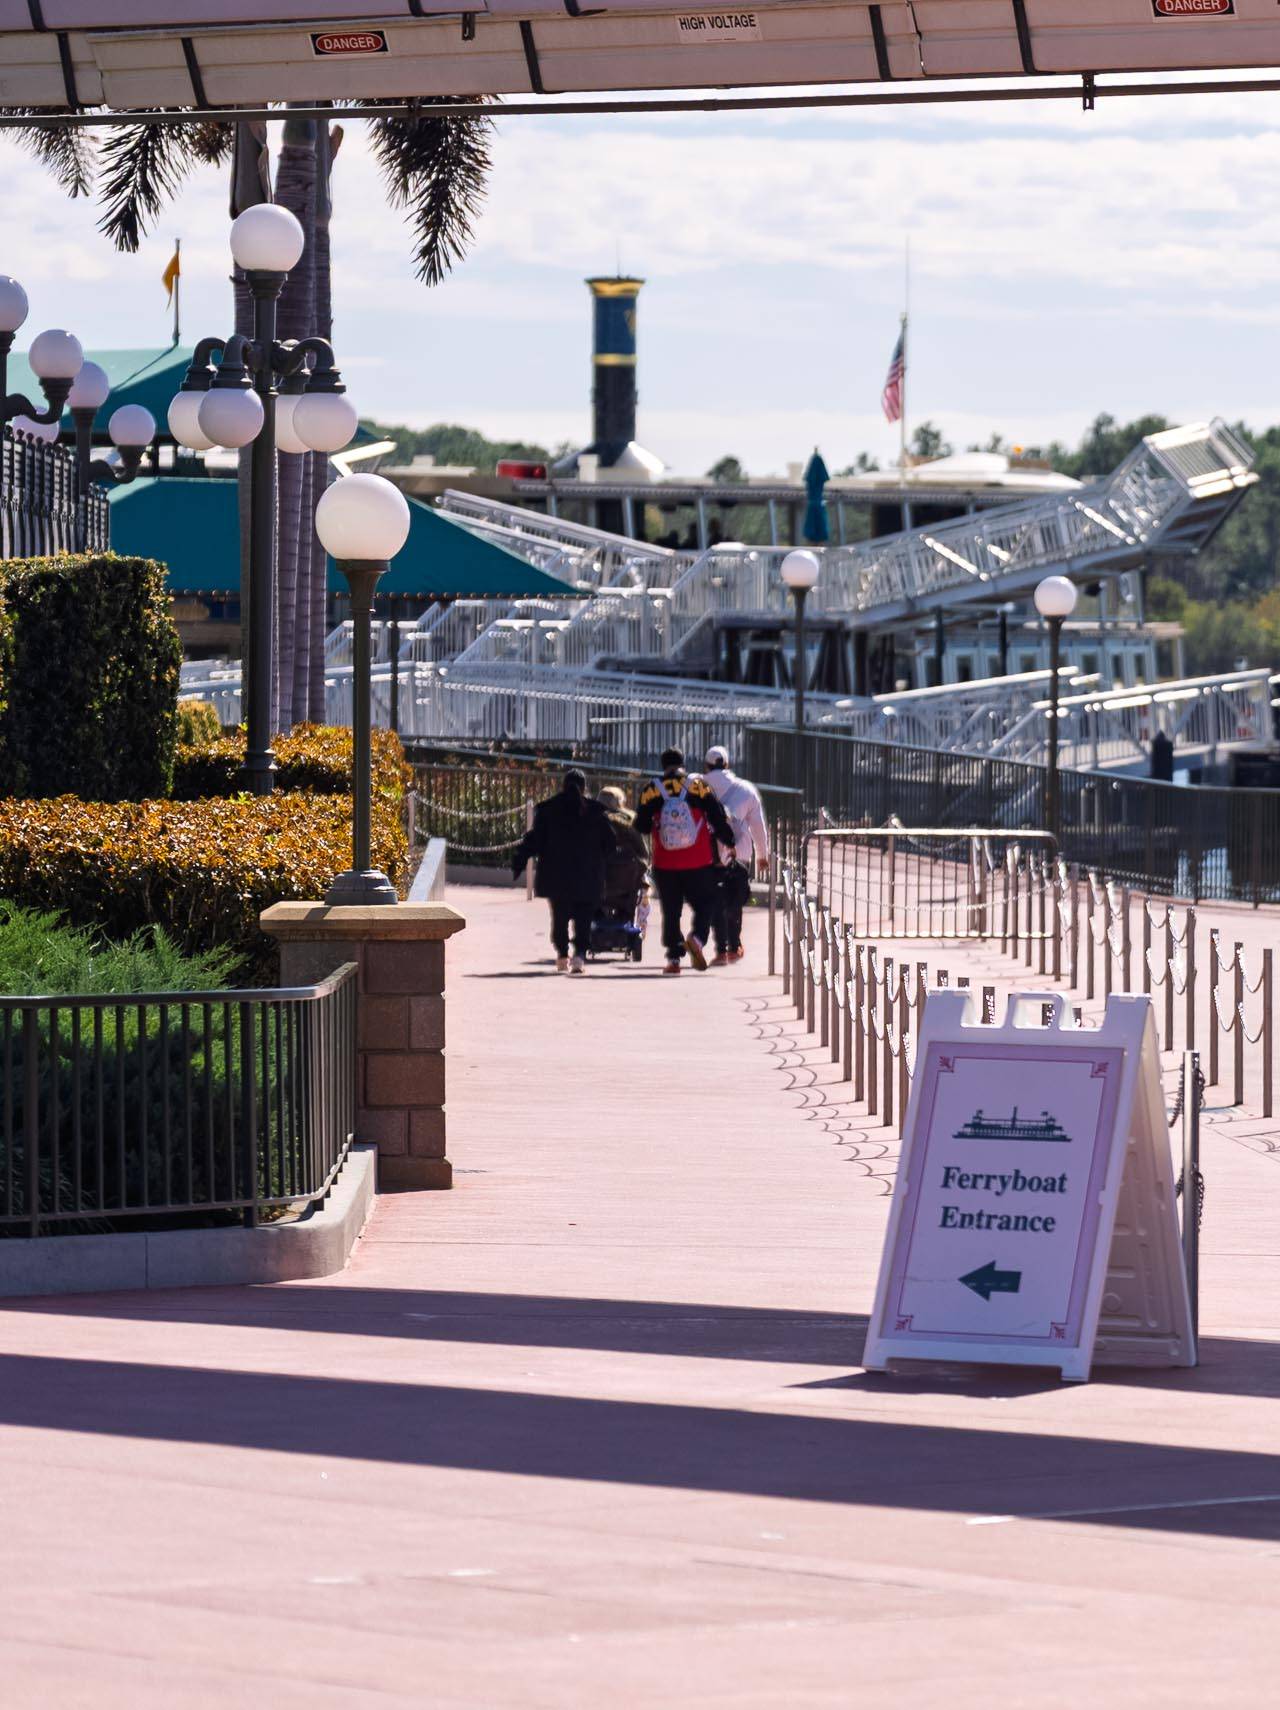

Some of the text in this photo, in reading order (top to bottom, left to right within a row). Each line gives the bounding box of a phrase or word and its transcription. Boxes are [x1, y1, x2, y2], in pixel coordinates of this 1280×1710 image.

[1164, 0, 1221, 11] DANGER
[679, 13, 757, 30] HIGH VOLTAGE
[323, 36, 377, 50] DANGER
[940, 1166, 1068, 1196] Ferryboat
[938, 1205, 1056, 1233] Entrance
